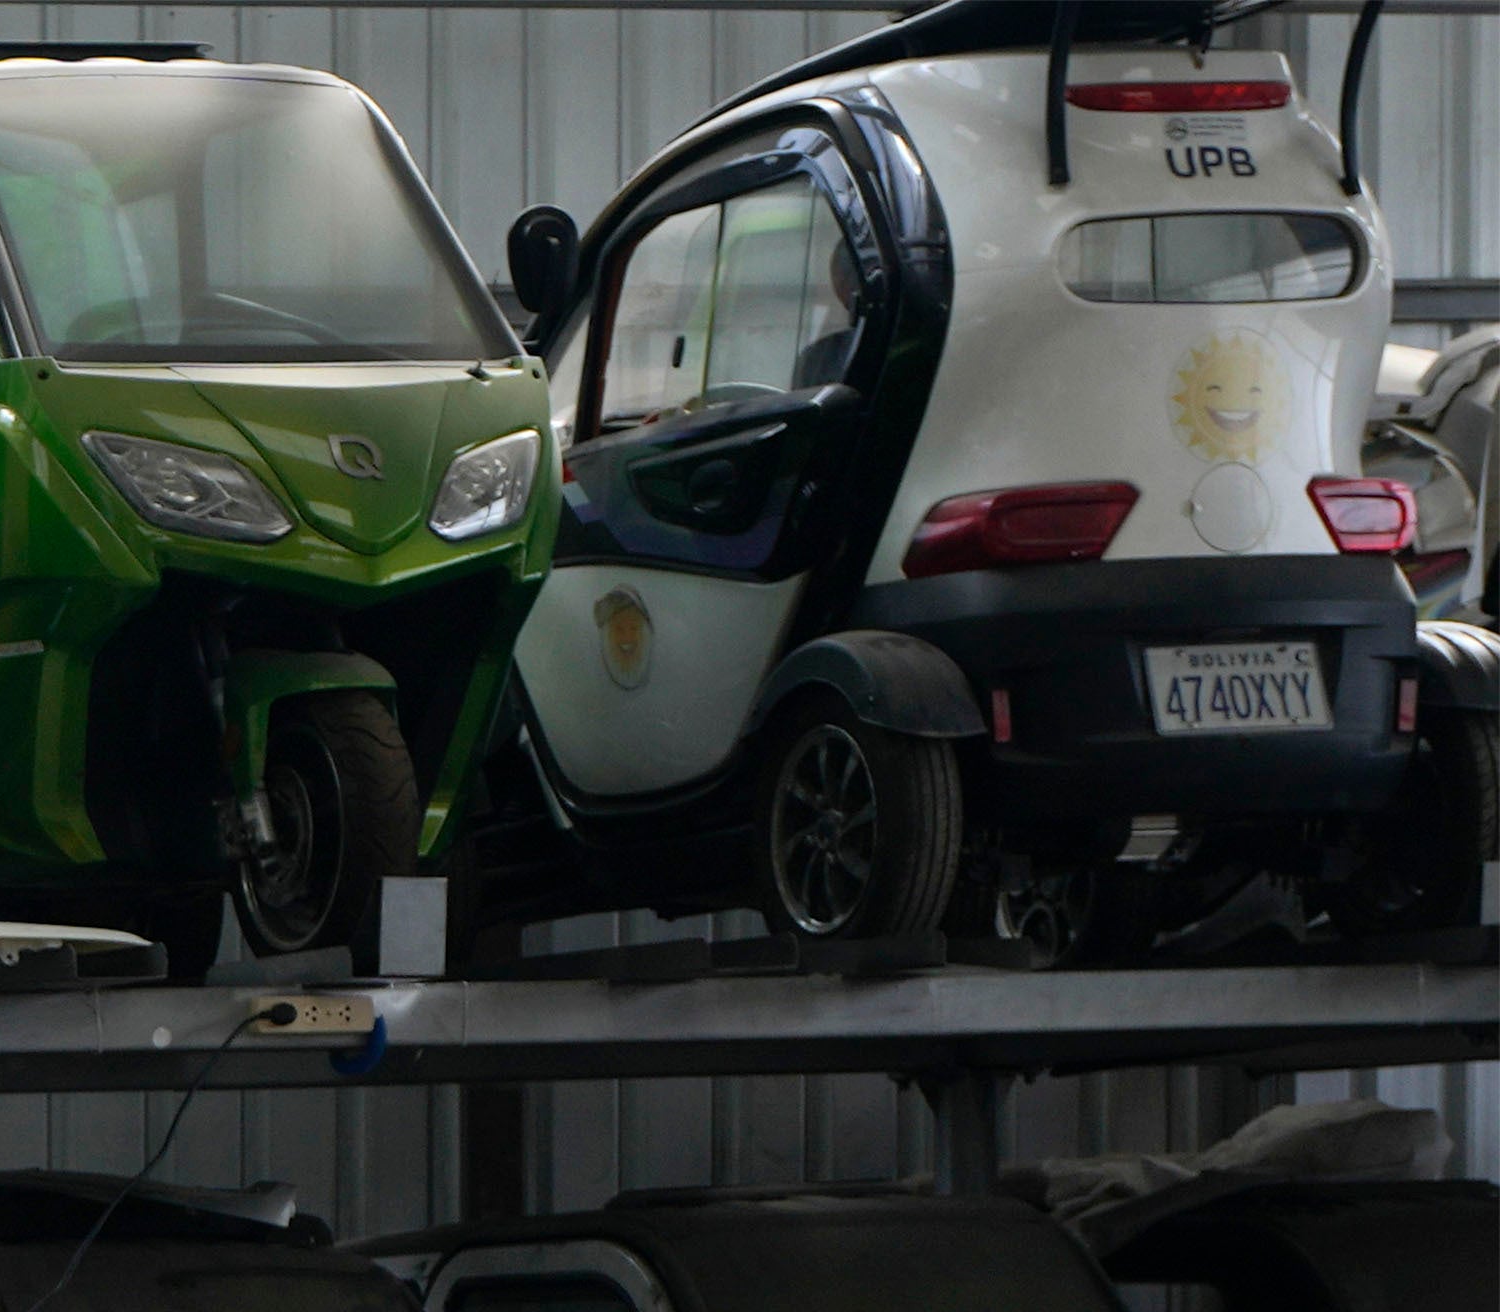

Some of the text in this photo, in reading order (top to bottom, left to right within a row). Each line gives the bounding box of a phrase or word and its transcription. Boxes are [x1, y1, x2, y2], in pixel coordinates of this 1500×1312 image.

[1165, 146, 1257, 177] UPB
[1188, 651, 1276, 667] BOLIVIA
[1166, 672, 1312, 721] 4740XYY
